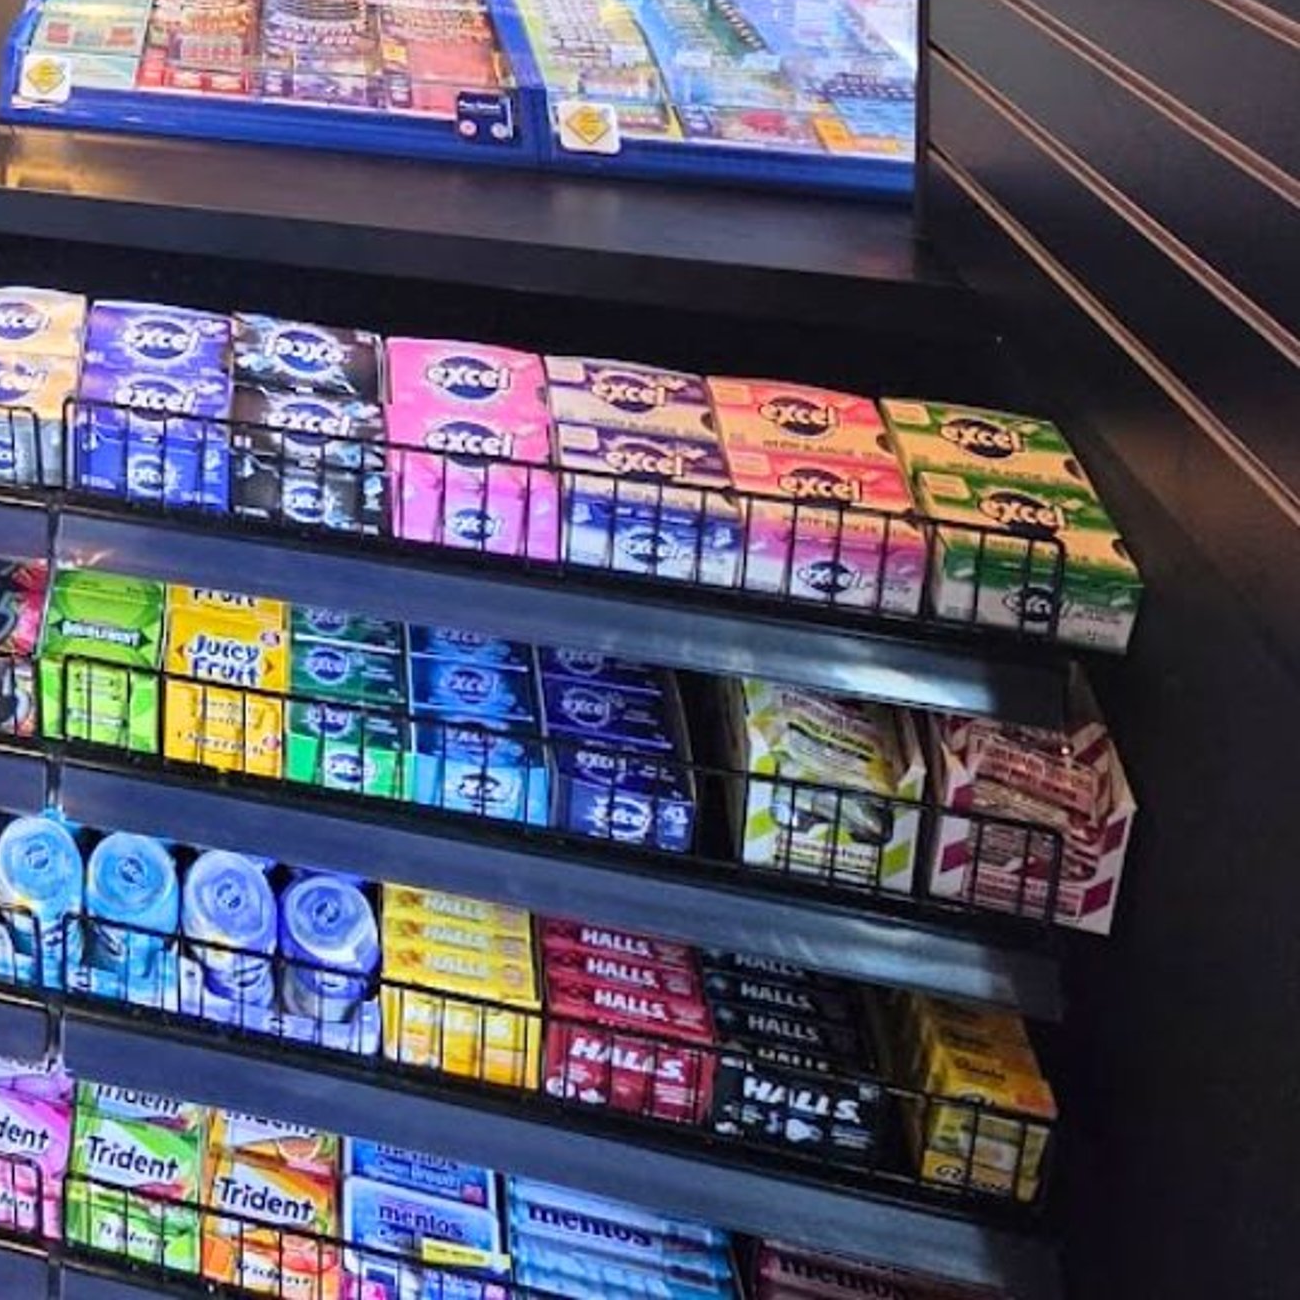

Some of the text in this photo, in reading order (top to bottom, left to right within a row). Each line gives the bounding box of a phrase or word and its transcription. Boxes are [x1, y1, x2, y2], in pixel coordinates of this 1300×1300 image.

[123, 322, 198, 354] excel
[425, 365, 514, 390] excel
[591, 377, 667, 408] excel
[114, 383, 197, 413] excel
[267, 408, 352, 438] excel
[759, 401, 838, 428] excel
[425, 427, 516, 457] excel
[939, 421, 1026, 455] excel
[606, 445, 687, 477] excel
[778, 474, 863, 502] excel
[977, 498, 1068, 532] excel
[580, 926, 653, 957] HALLS
[586, 956, 660, 989] HALLS
[593, 988, 668, 1022] HALLS
[740, 981, 817, 1011] HALLS
[747, 1013, 821, 1044] HALLS
[571, 1035, 686, 1083] HALLS
[742, 1074, 862, 1124] HALLS
[87, 1134, 180, 1180] Trident
[216, 1176, 315, 1222] Trident
[378, 1203, 463, 1239] mentos
[527, 1202, 653, 1249] mentos
